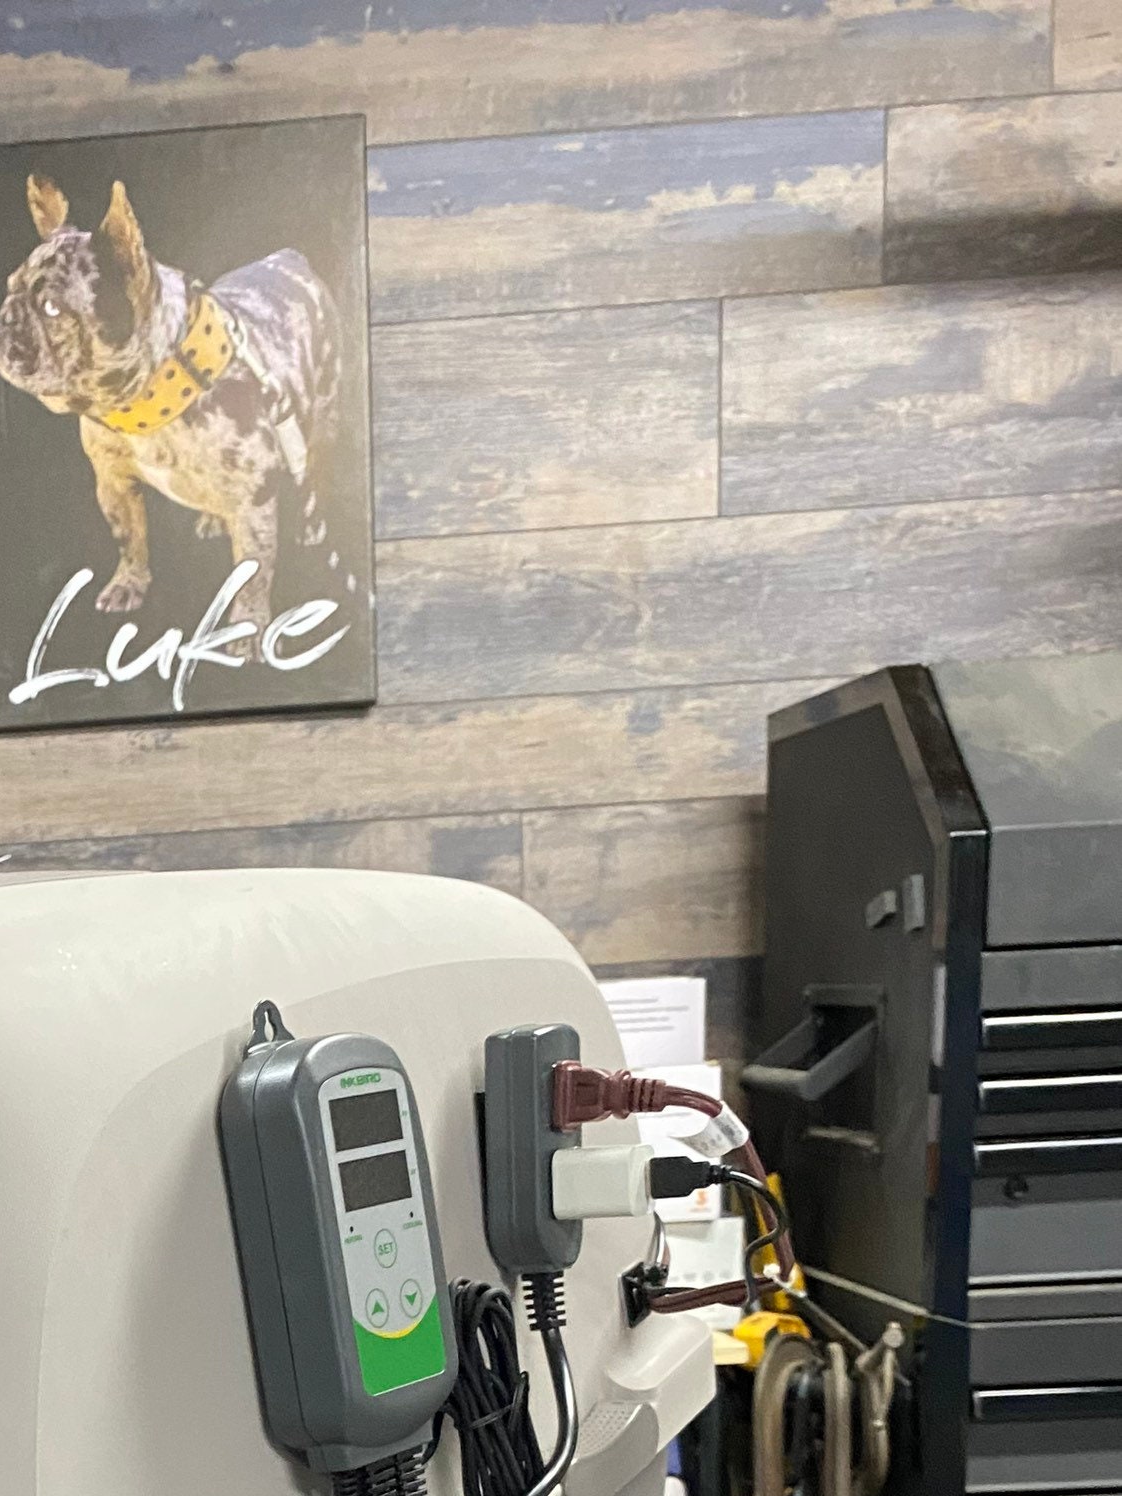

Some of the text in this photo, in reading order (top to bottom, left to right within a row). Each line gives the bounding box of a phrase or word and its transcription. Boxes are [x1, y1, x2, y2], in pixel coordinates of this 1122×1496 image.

[8, 561, 351, 712] Luke
[340, 1072, 382, 1088] INKBIRD
[377, 1242, 394, 1256] SET
